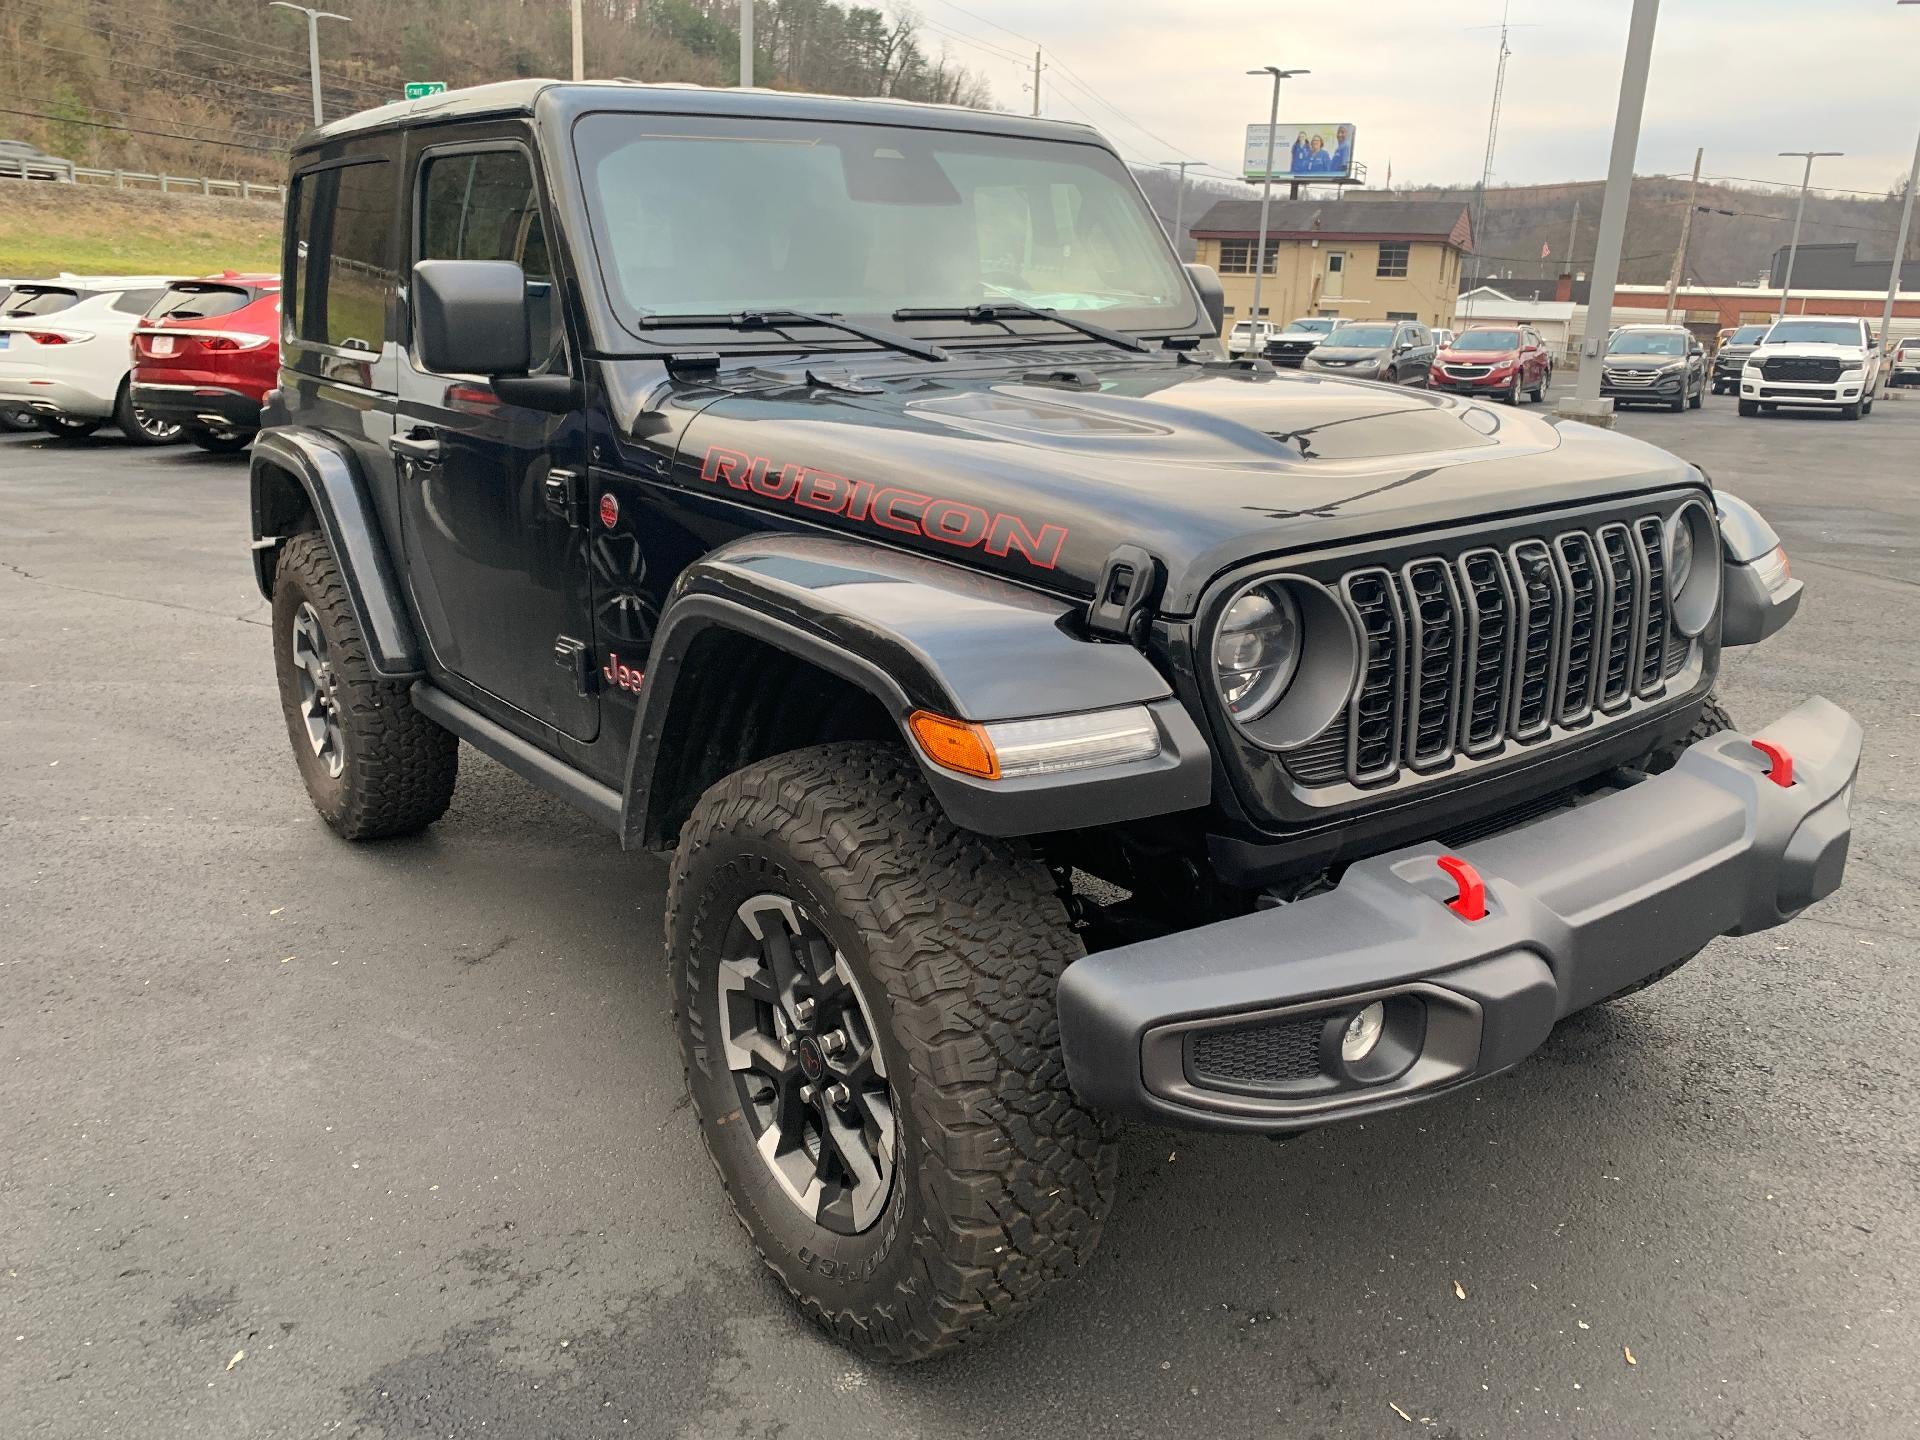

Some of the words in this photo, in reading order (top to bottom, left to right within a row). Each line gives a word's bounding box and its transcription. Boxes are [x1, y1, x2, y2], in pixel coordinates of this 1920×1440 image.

[409, 88, 423, 96] EXIT
[428, 86, 441, 97] 24
[701, 446, 1068, 568] RUBICON
